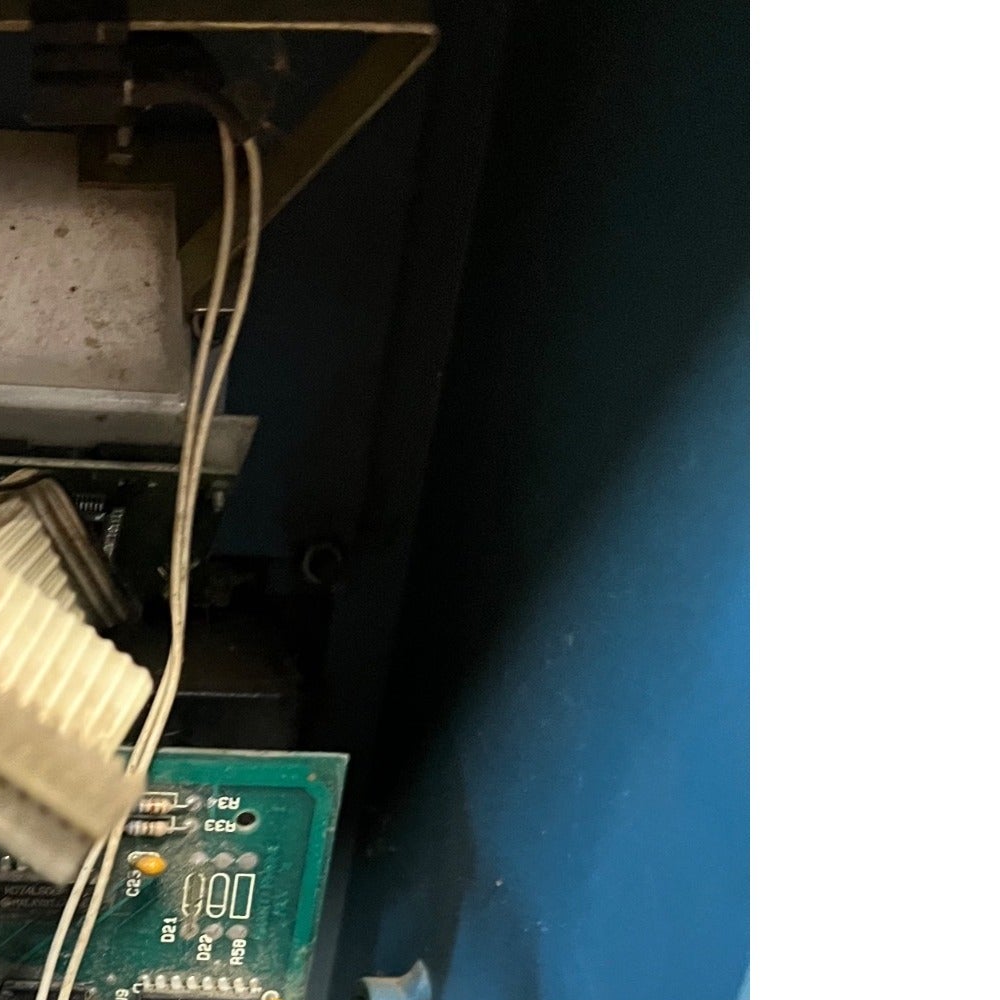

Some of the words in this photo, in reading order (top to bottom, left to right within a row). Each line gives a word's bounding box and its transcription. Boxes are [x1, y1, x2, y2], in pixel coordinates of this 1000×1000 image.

[203, 818, 236, 833] R33
[160, 916, 178, 943] D21
[196, 933, 213, 961] D22
[229, 938, 247, 966] R58
